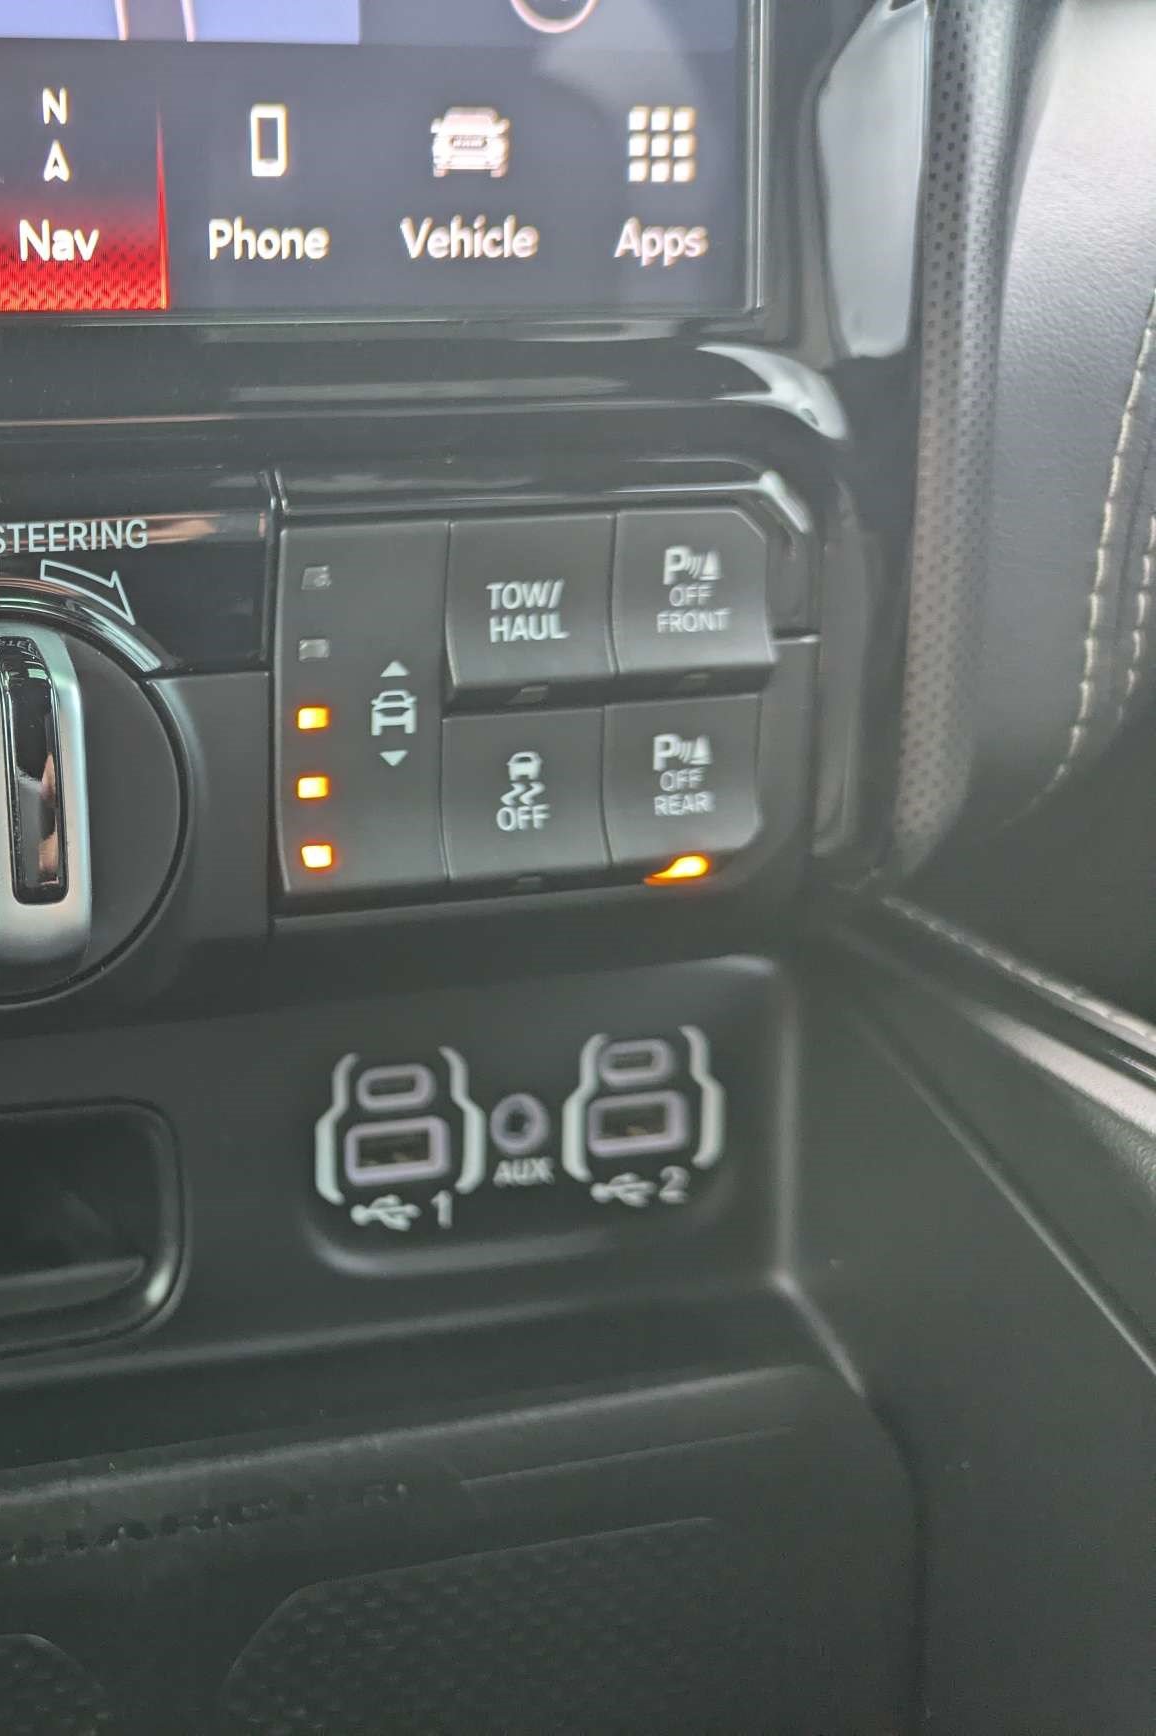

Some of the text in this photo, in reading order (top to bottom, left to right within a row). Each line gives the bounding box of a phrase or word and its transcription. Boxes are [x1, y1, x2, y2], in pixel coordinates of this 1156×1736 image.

[18, 218, 100, 262] Nav
[208, 217, 330, 261] Phone
[400, 215, 540, 260] Vehicle
[614, 217, 709, 267] Apps
[485, 579, 565, 611] TOW/
[669, 584, 715, 607] OFF
[489, 613, 570, 643] HAUL
[656, 608, 732, 633] FRONT
[659, 767, 705, 792] OFF
[496, 804, 551, 832] OFF
[653, 791, 715, 817] REAR
[492, 1157, 556, 1187] AUX
[658, 1166, 691, 1204] 2
[430, 1190, 453, 1229] 1
